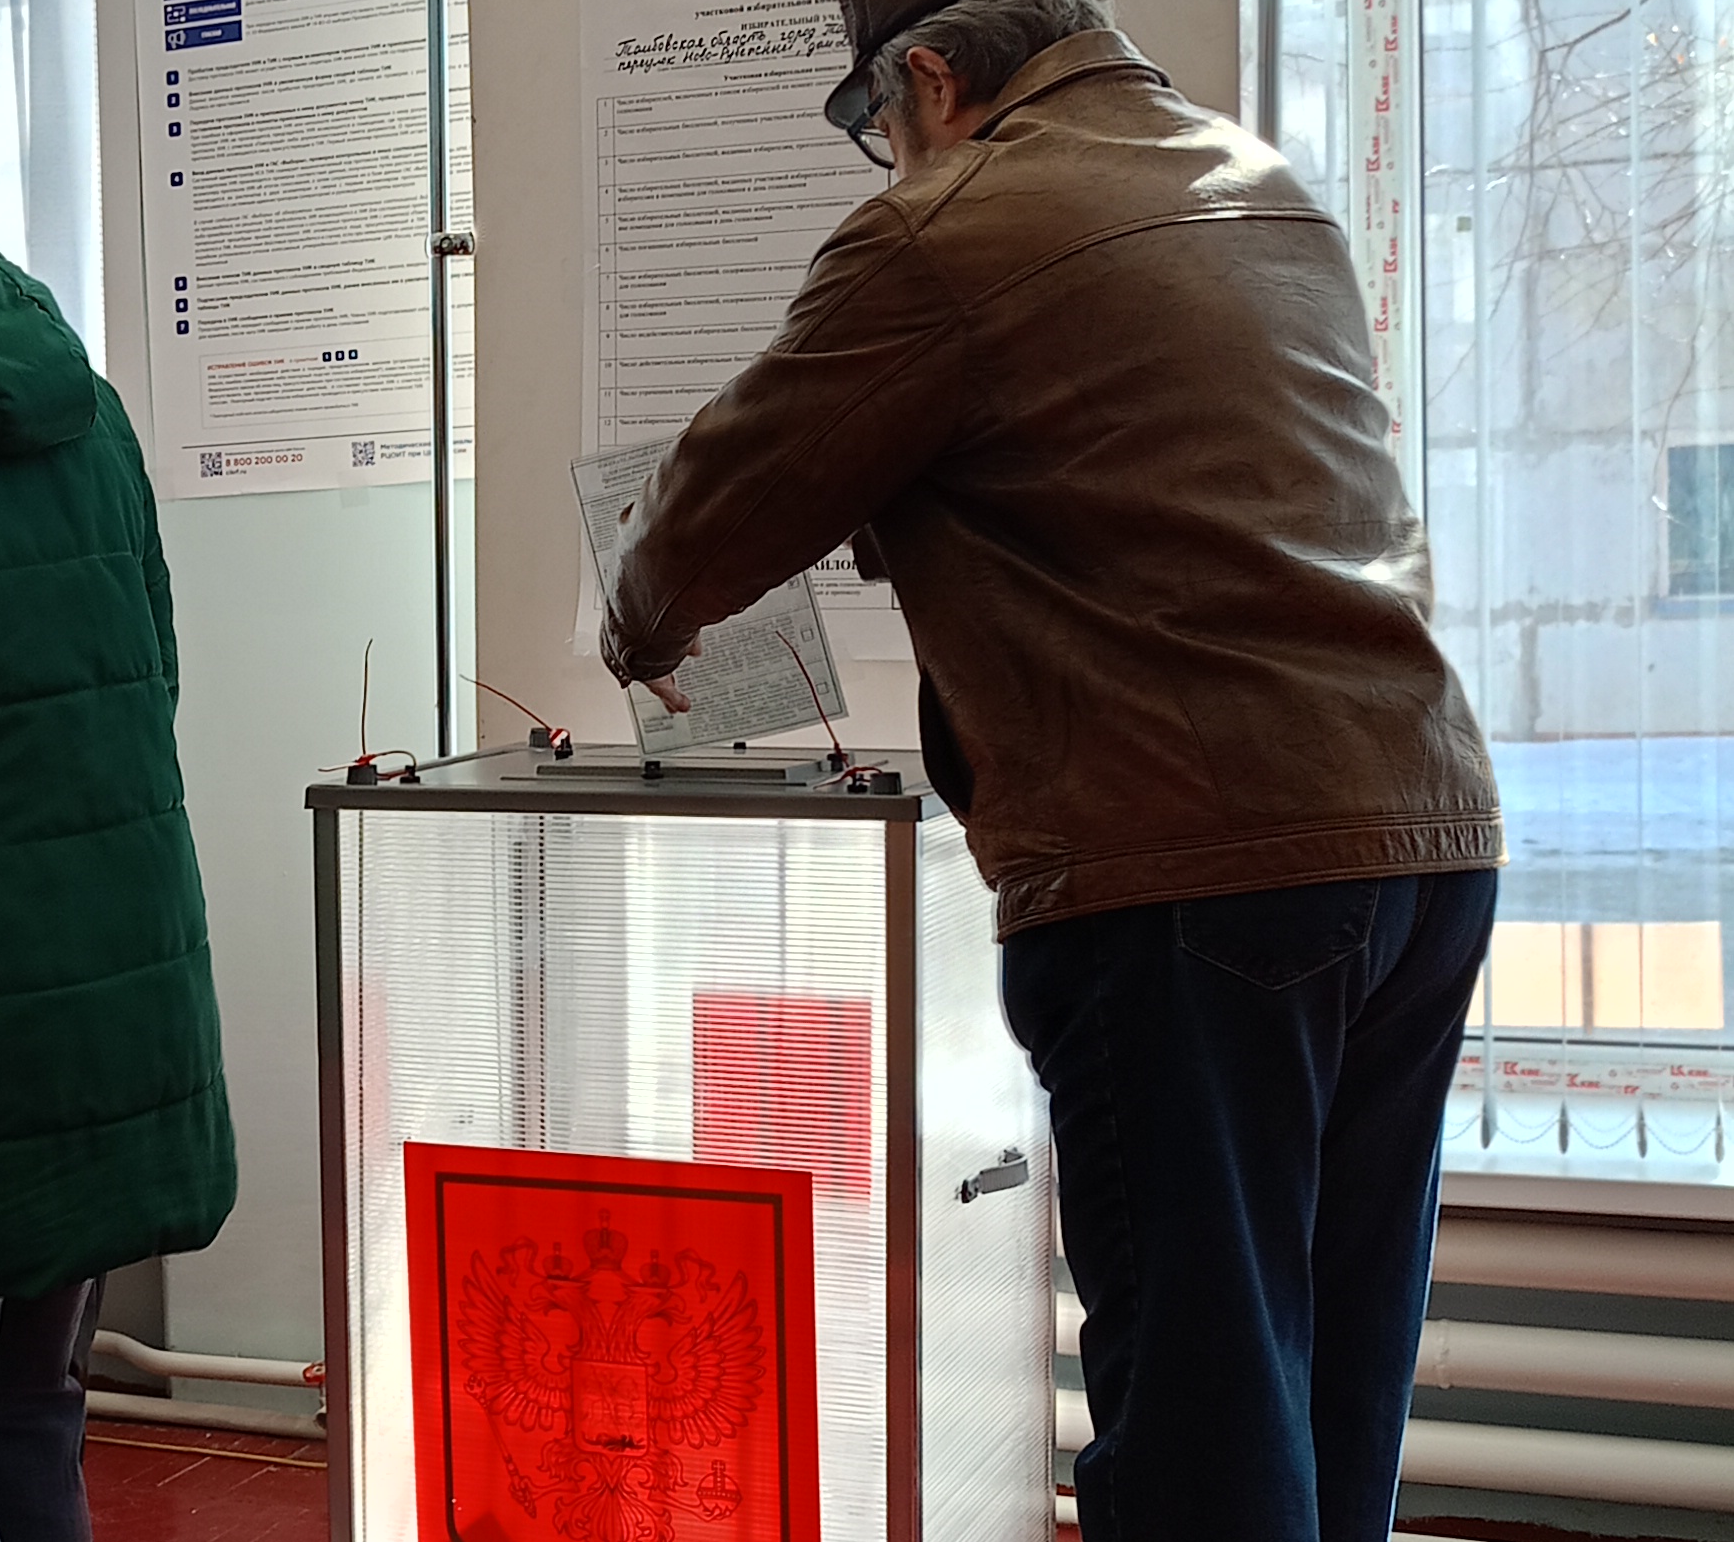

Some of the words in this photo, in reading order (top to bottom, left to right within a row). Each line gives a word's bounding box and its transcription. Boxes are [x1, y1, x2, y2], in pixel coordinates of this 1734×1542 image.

[255, 455, 273, 465] 200
[275, 454, 289, 463] 00
[291, 453, 303, 462] 20
